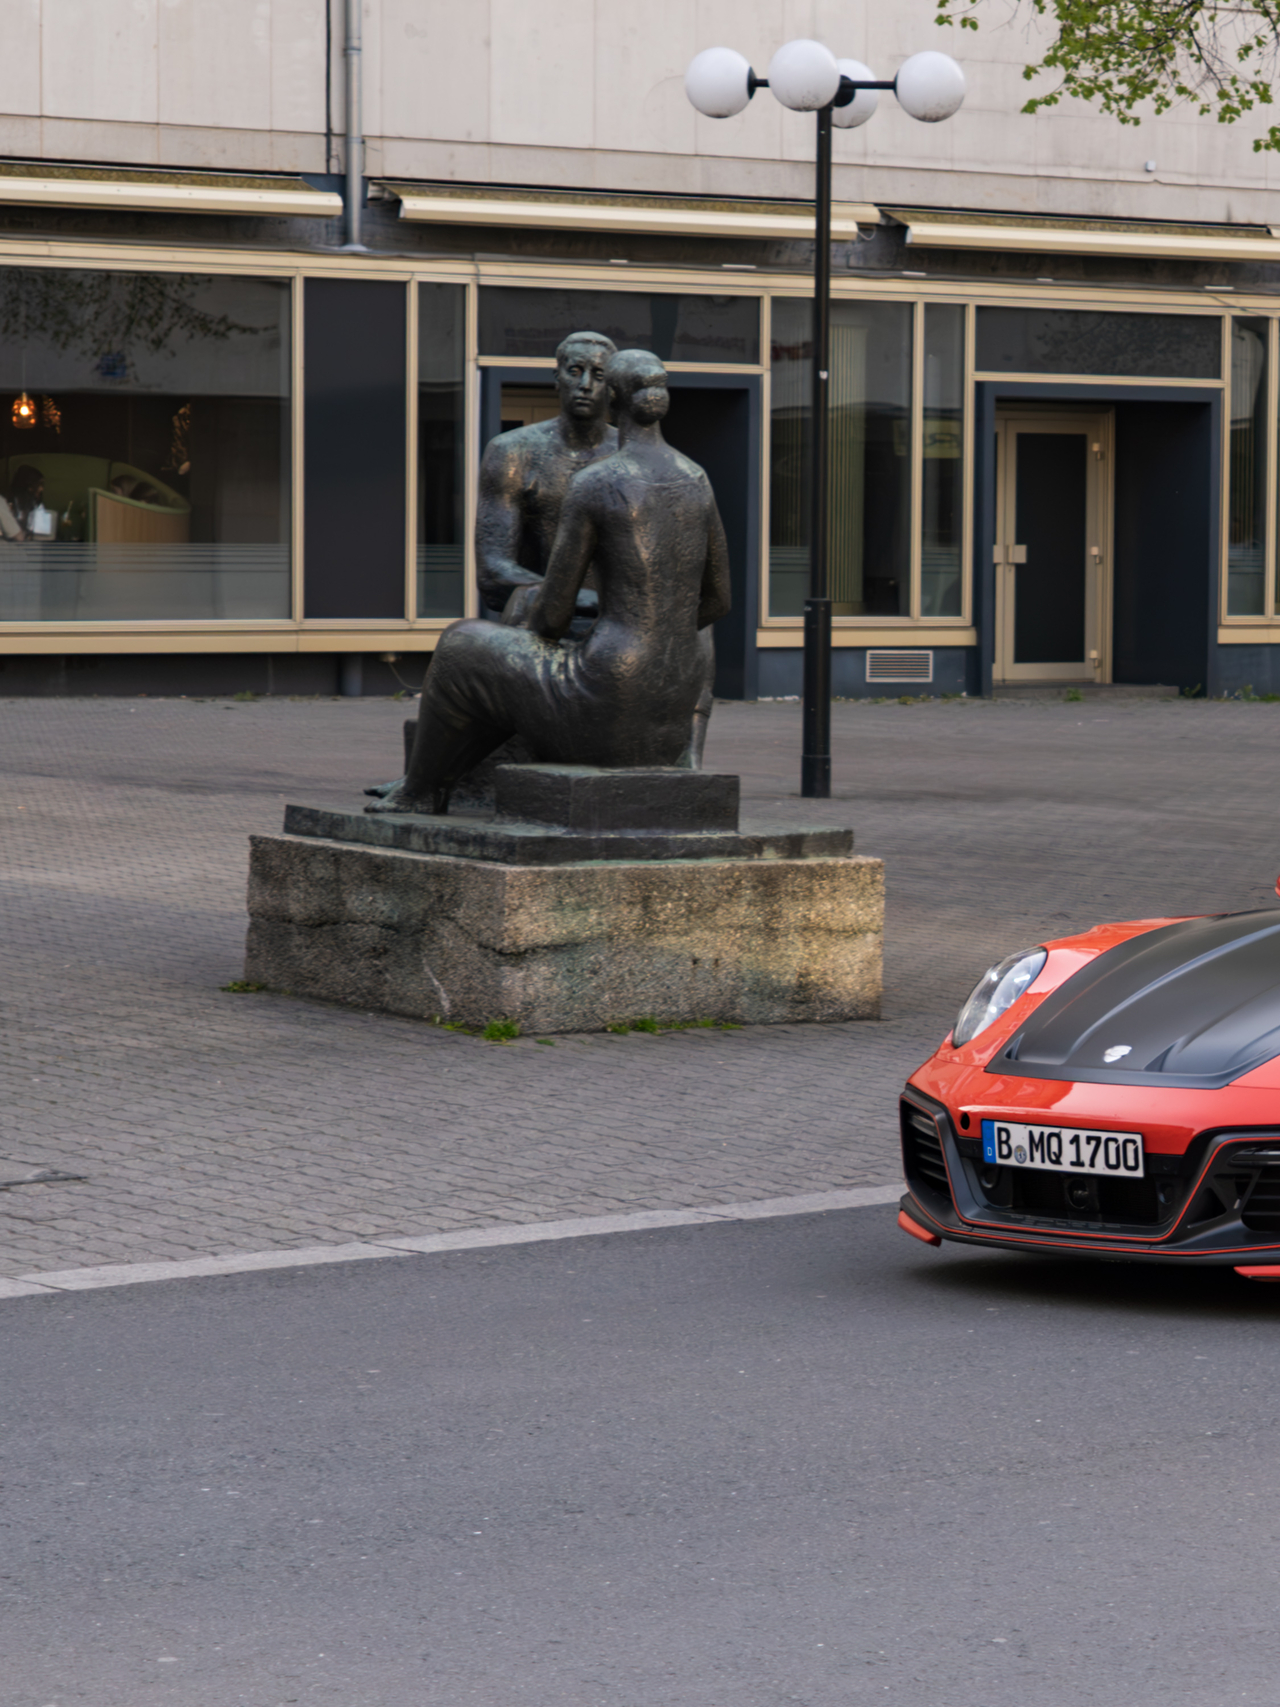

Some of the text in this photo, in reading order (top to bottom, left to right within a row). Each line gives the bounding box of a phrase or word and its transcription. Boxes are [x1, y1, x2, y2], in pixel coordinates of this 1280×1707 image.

[987, 1147, 993, 1157] D
[997, 1126, 1140, 1171] B MQ 1700
